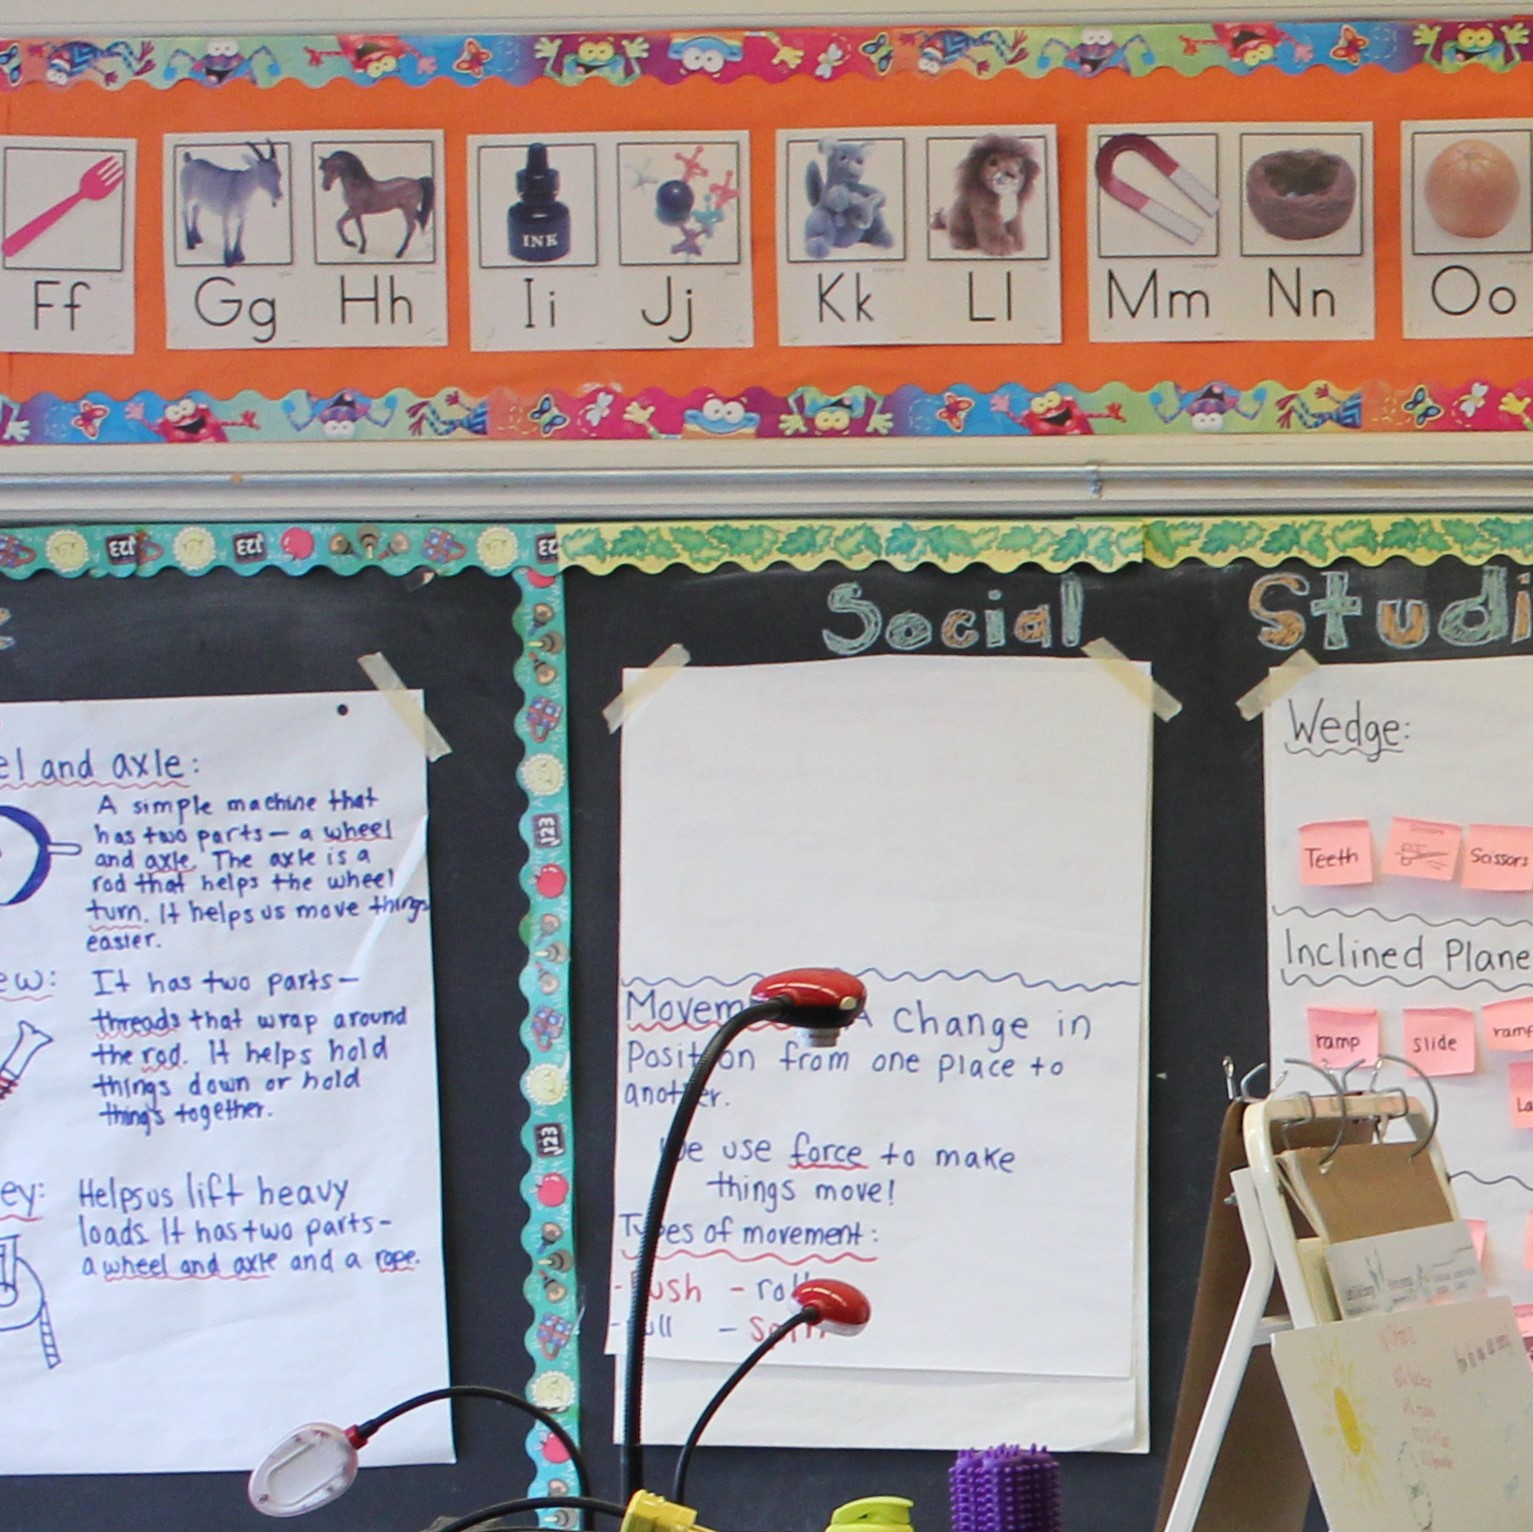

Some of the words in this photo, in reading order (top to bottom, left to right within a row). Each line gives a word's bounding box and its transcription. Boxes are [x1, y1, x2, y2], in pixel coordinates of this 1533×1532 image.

[522, 233, 559, 248] INK
[33, 279, 91, 332] Ff
[817, 272, 874, 323] Kk
[967, 270, 1013, 323] Ll
[1107, 268, 1210, 320] Mm
[1267, 266, 1336, 318] Nn
[1430, 264, 1517, 317] Oo
[194, 275, 277, 344] Gg
[339, 274, 413, 325] Hh
[523, 277, 556, 329] Ii
[640, 275, 694, 344] Jj
[822, 572, 1084, 656] Social
[1285, 696, 1411, 762] Wedge:
[40, 747, 94, 782] and
[111, 748, 199, 780] axle:
[97, 793, 117, 815] A
[132, 798, 214, 823] simple
[225, 795, 317, 812] machine
[327, 786, 378, 811] that
[92, 823, 136, 846] has
[142, 827, 188, 844] two
[298, 827, 313, 840] a
[322, 818, 392, 839] wheel
[94, 850, 134, 868] and
[210, 848, 252, 872] The
[268, 848, 316, 868] axle
[326, 849, 347, 867] is
[356, 848, 370, 863] a
[1304, 847, 1360, 870] Teeth
[1470, 847, 1529, 868] Scissors
[91, 872, 126, 893] rod
[133, 871, 185, 894] that
[201, 871, 260, 898] helps
[270, 872, 313, 892] the
[327, 867, 394, 891] wheel
[85, 900, 149, 923] turn.
[159, 901, 180, 925] It
[188, 899, 255, 931] helps
[259, 904, 286, 921] us
[294, 901, 359, 920] move
[367, 896, 431, 924] things
[85, 931, 163, 952] easier.
[1285, 927, 1424, 970] Inclined
[90, 969, 130, 997] It
[146, 971, 192, 993] has
[201, 970, 250, 994] two
[89, 1006, 182, 1033] threads
[187, 1007, 242, 1031] that
[256, 1012, 317, 1034] wrap
[333, 1005, 407, 1029] around
[892, 1001, 1027, 1053] change
[1058, 1014, 1092, 1041] in
[90, 1043, 133, 1065] the
[244, 1038, 313, 1068] helps
[327, 1033, 388, 1063] hold
[1315, 1033, 1361, 1051] ramp
[1412, 1033, 1457, 1054] slide
[778, 1039, 849, 1072] from
[871, 1050, 921, 1074] one
[936, 1041, 1016, 1081] place
[1029, 1056, 1064, 1077] to
[91, 1073, 172, 1104] things
[187, 1071, 251, 1096] down
[264, 1076, 292, 1092] or
[302, 1068, 360, 1091] hold
[173, 1099, 272, 1131] together.
[721, 1138, 772, 1163] use
[789, 1130, 863, 1168] force
[880, 1142, 915, 1168] to
[935, 1147, 1016, 1174] make
[77, 1175, 143, 1215] Helps
[146, 1187, 175, 1209] us
[186, 1171, 244, 1209] lift
[256, 1175, 349, 1212] heavy
[705, 1170, 796, 1214] things
[814, 1178, 896, 1204] move!
[160, 1215, 186, 1243] It
[194, 1220, 238, 1243] has
[241, 1219, 293, 1243] two
[703, 1214, 734, 1244] of
[741, 1220, 880, 1247] movement:
[102, 1252, 168, 1277] wheel
[179, 1252, 220, 1276] and
[232, 1251, 278, 1276] axle
[289, 1247, 335, 1274] and
[343, 1251, 362, 1269] a
[374, 1248, 420, 1271] rope.
